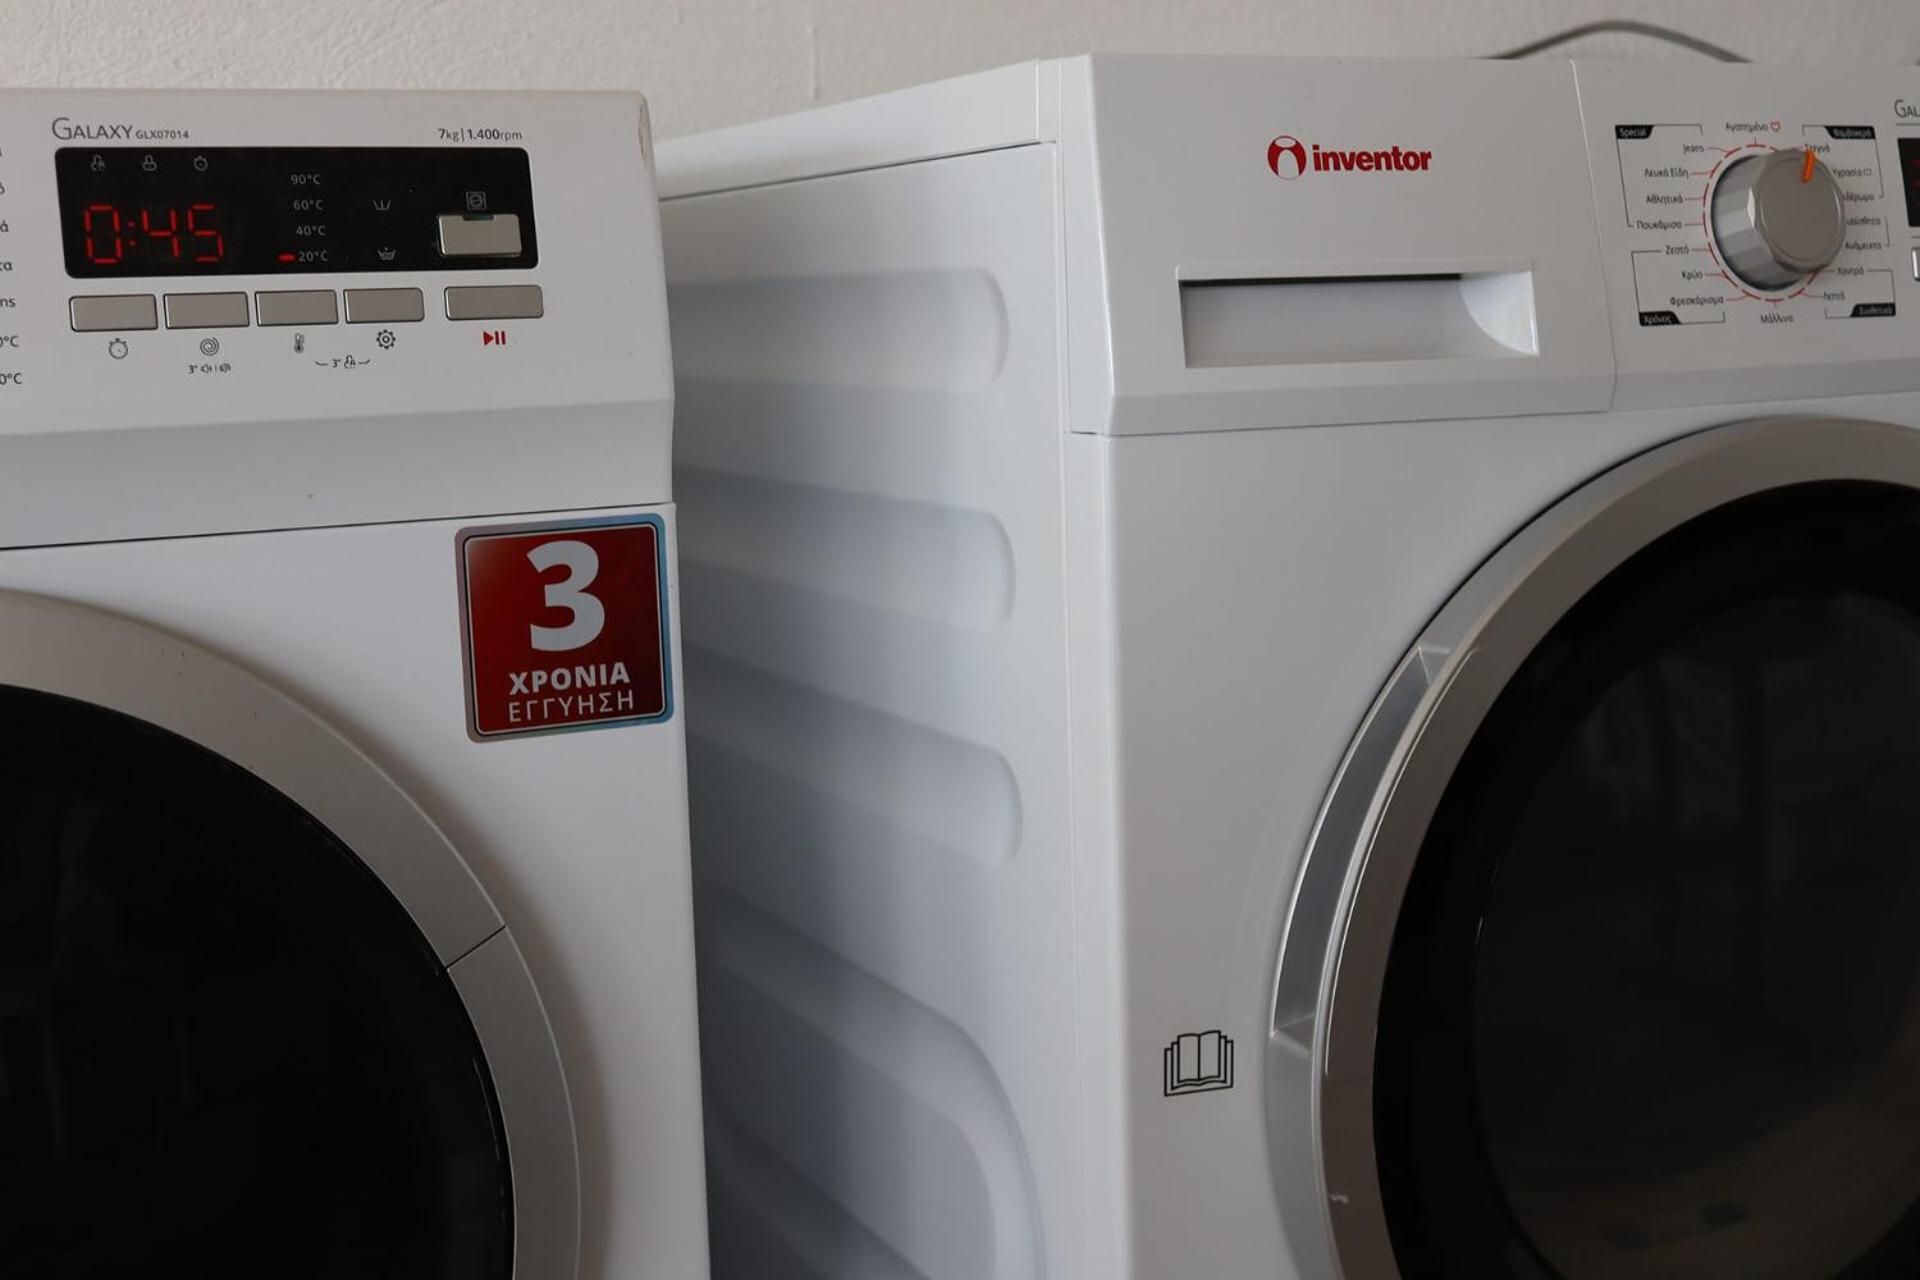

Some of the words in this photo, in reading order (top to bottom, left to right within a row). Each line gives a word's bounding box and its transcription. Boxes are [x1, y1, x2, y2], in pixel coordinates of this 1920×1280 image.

[135, 129, 190, 140] GLX07014
[1619, 128, 1647, 139] Special
[1683, 144, 1704, 154] Jeans
[1312, 144, 1432, 171] inventor
[290, 173, 321, 186] 90°C
[293, 198, 324, 211] 60°C
[296, 224, 326, 237] 40°C
[1636, 220, 1683, 231] Πουκάμισα
[84, 204, 224, 263] 0:45
[298, 249, 329, 262] 20°C
[1665, 244, 1690, 255] Ζεστό
[1681, 271, 1703, 281] Κρύο
[526, 540, 605, 652] 3
[509, 662, 630, 695] ΧΡΟΝΙΑ
[509, 690, 634, 723] ΕΓΓΥΗΣΗ
